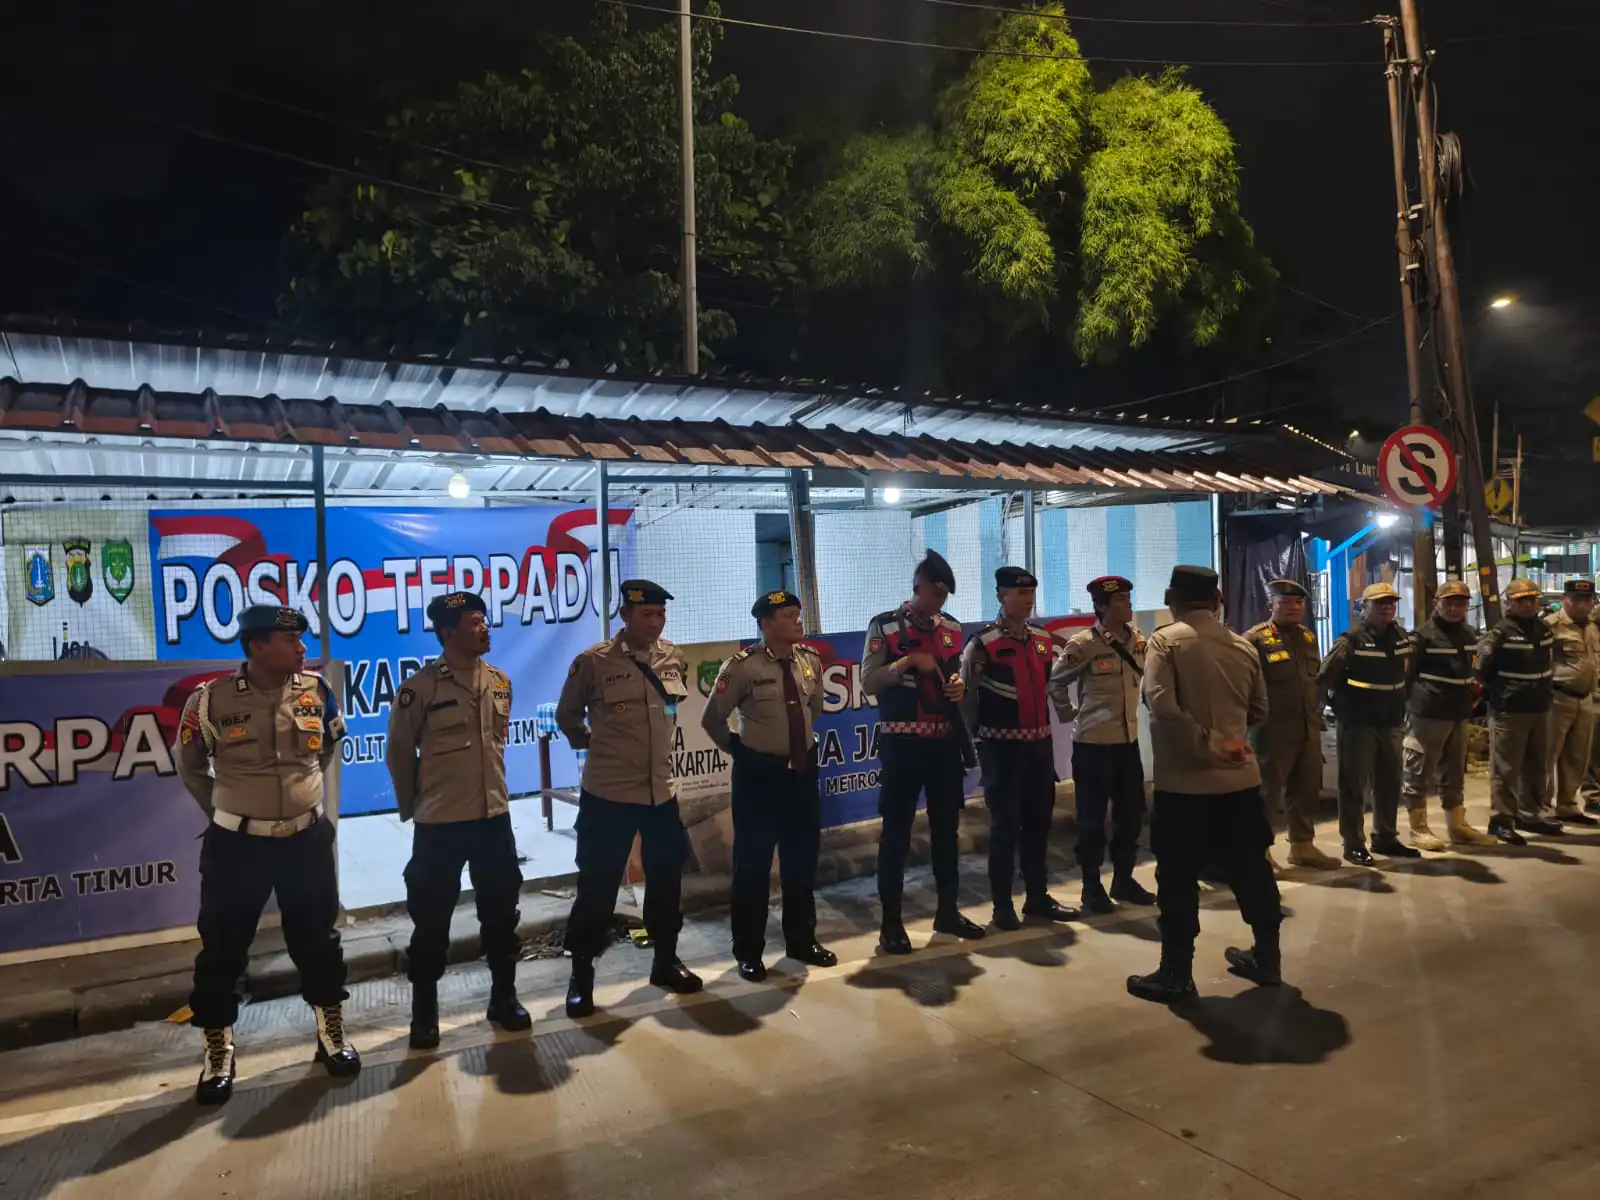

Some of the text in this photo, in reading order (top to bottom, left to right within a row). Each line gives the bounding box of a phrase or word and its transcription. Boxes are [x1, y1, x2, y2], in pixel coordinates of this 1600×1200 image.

[1355, 462, 1378, 478] LANT
[1398, 442, 1437, 495] S
[160, 549, 622, 645] POSKO TERPADU
[344, 656, 440, 718] KA
[505, 716, 560, 748] TIM
[825, 768, 883, 796] METRO
[72, 861, 177, 896] TIMUR
